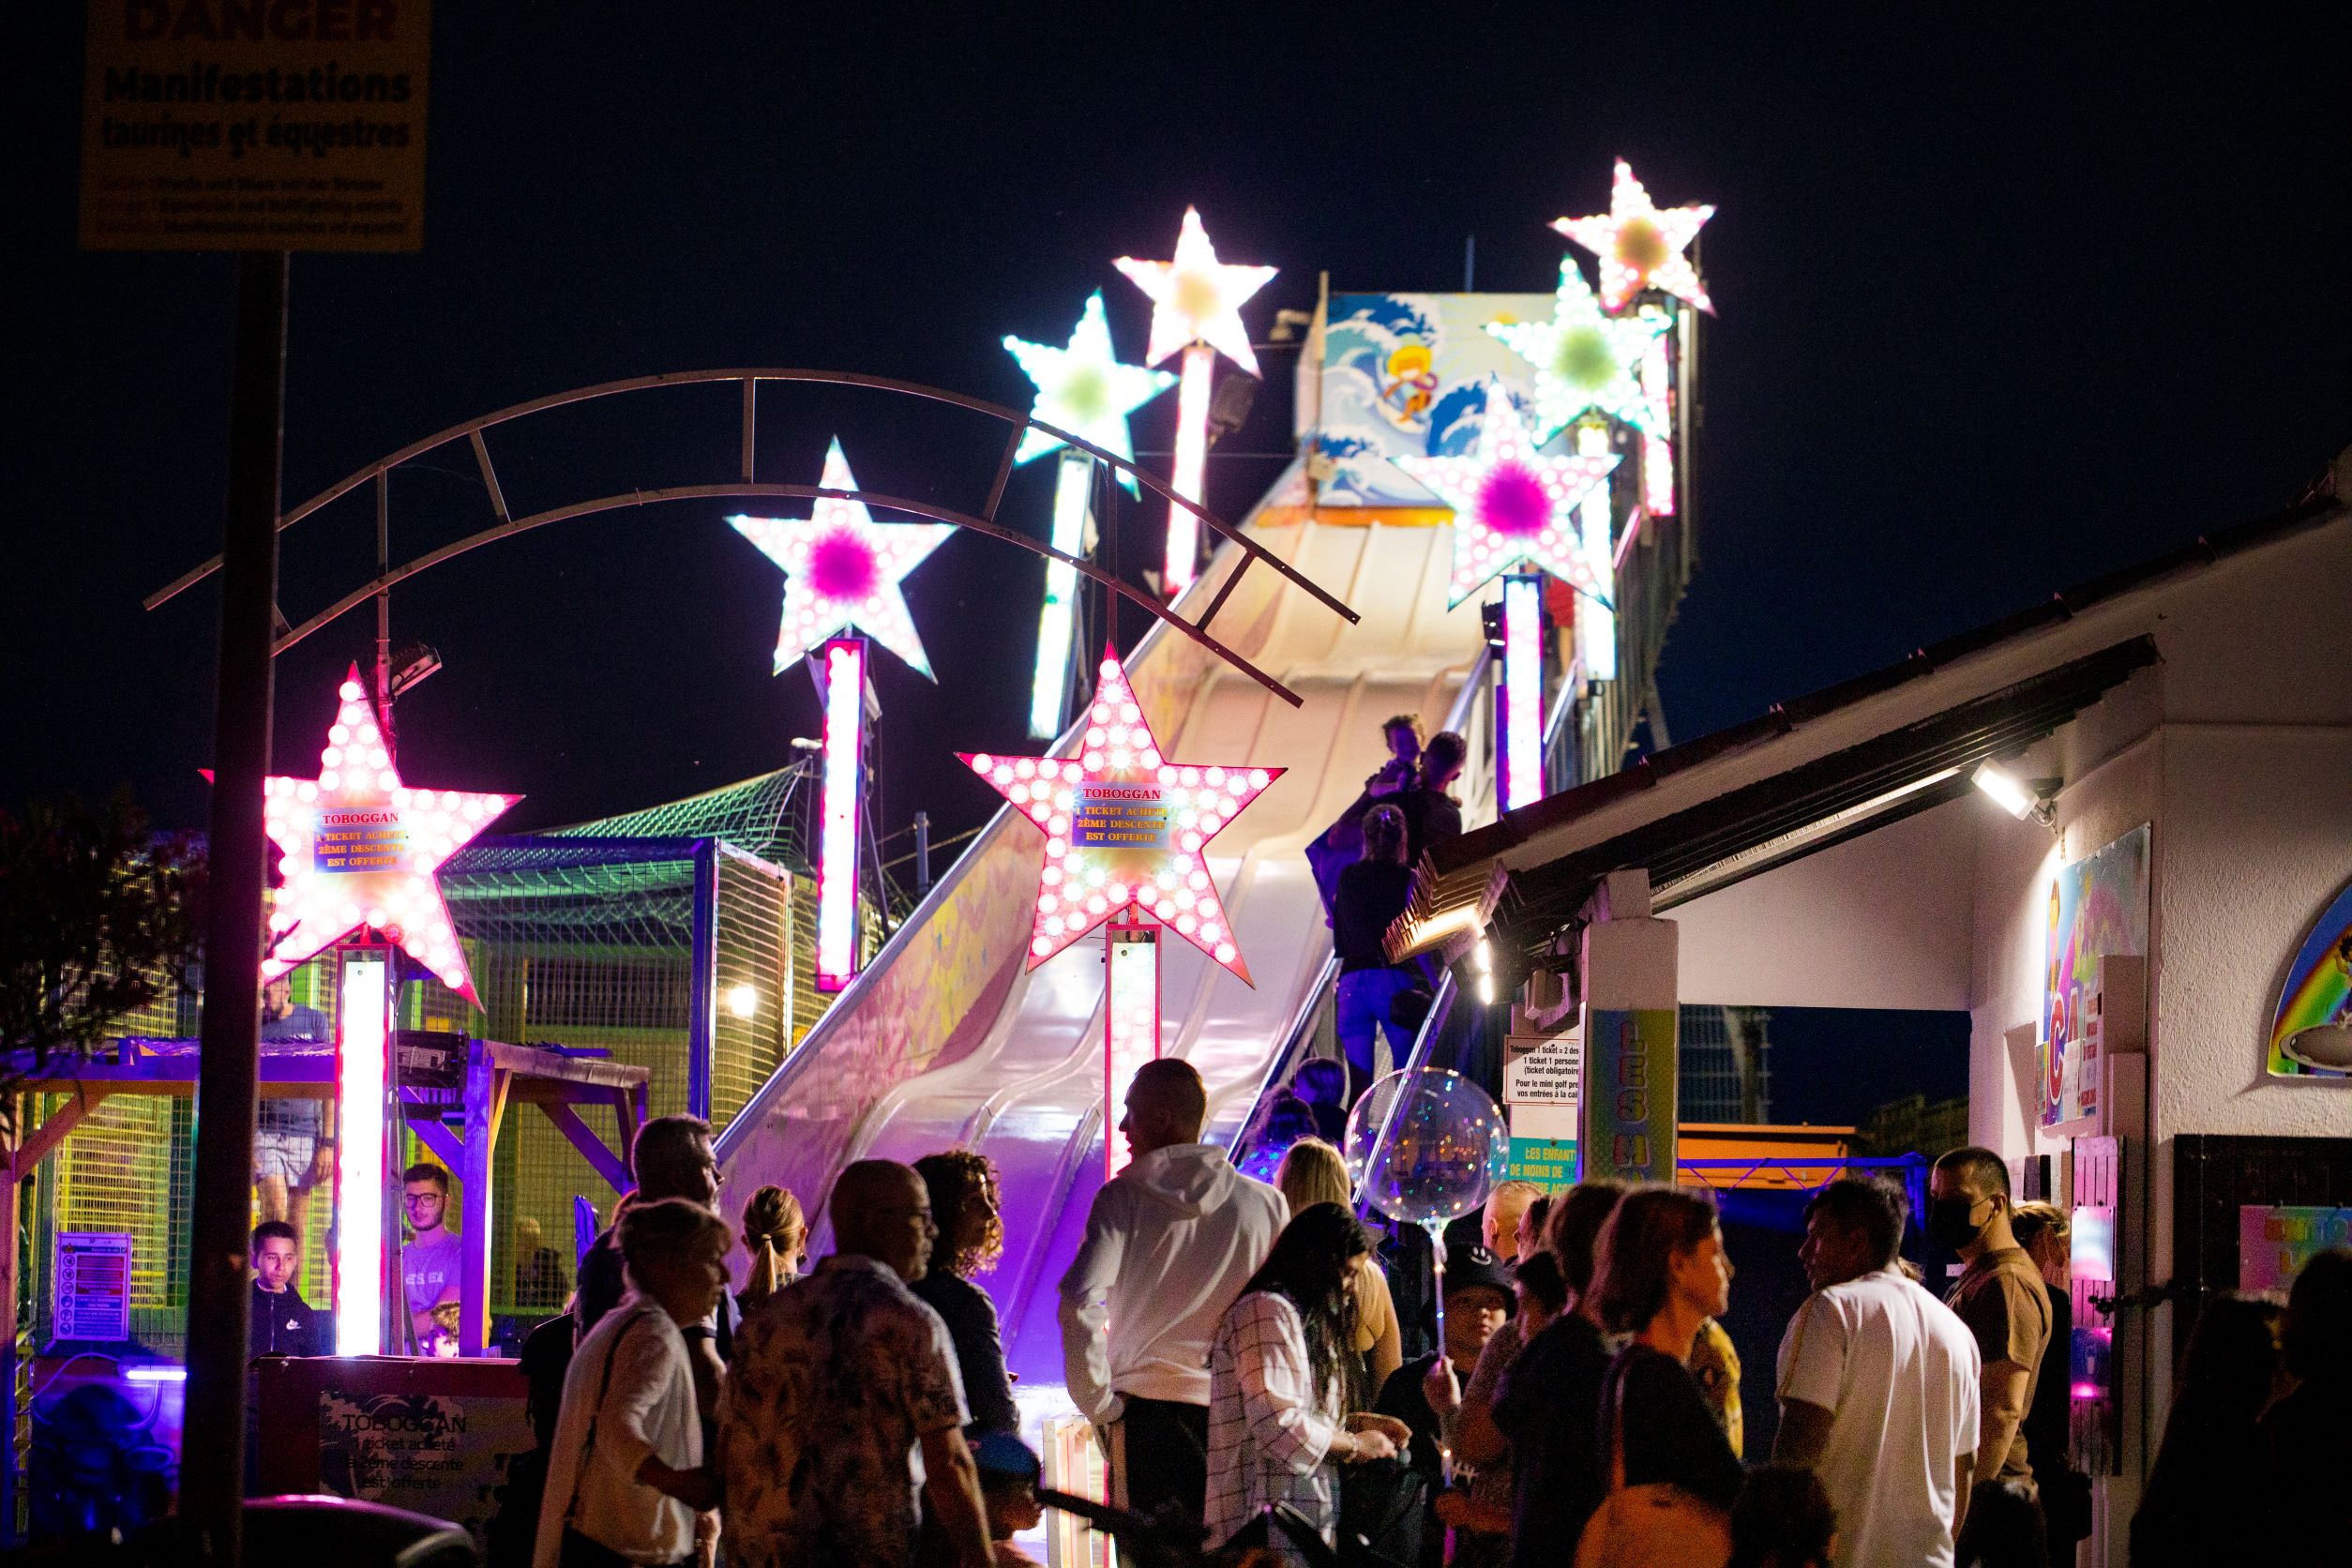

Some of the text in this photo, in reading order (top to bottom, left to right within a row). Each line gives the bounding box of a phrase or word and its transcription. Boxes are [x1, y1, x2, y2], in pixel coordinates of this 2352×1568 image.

[122, 0, 399, 42] DANGER
[103, 61, 413, 102] Manifestations
[102, 112, 410, 157] taurines et équestres
[1083, 788, 1162, 800] TOBOGGAN
[1084, 807, 1123, 816] TICKET
[323, 812, 400, 824] TOBOGGAN
[1109, 820, 1165, 830] DESCENTE
[324, 832, 362, 841] TICKET
[1085, 832, 1156, 842] EST OFFERTE
[351, 844, 405, 853] DESCENTE
[327, 855, 398, 867] EST OFFERTE
[1510, 1046, 1535, 1054] Toboggan
[1524, 1066, 1545, 1076] (ticket
[1555, 1080, 1567, 1089] golf
[1555, 1090, 1559, 1098] à
[1525, 1147, 1576, 1161] LES ENFANT
[1510, 1164, 1520, 1176] DE
[1523, 1165, 1549, 1177] MOINS
[1552, 1166, 1563, 1178] DE
[342, 1414, 466, 1433] TOBOGGAN
[402, 1456, 463, 1470] descente
[389, 1475, 442, 1488] offerte
